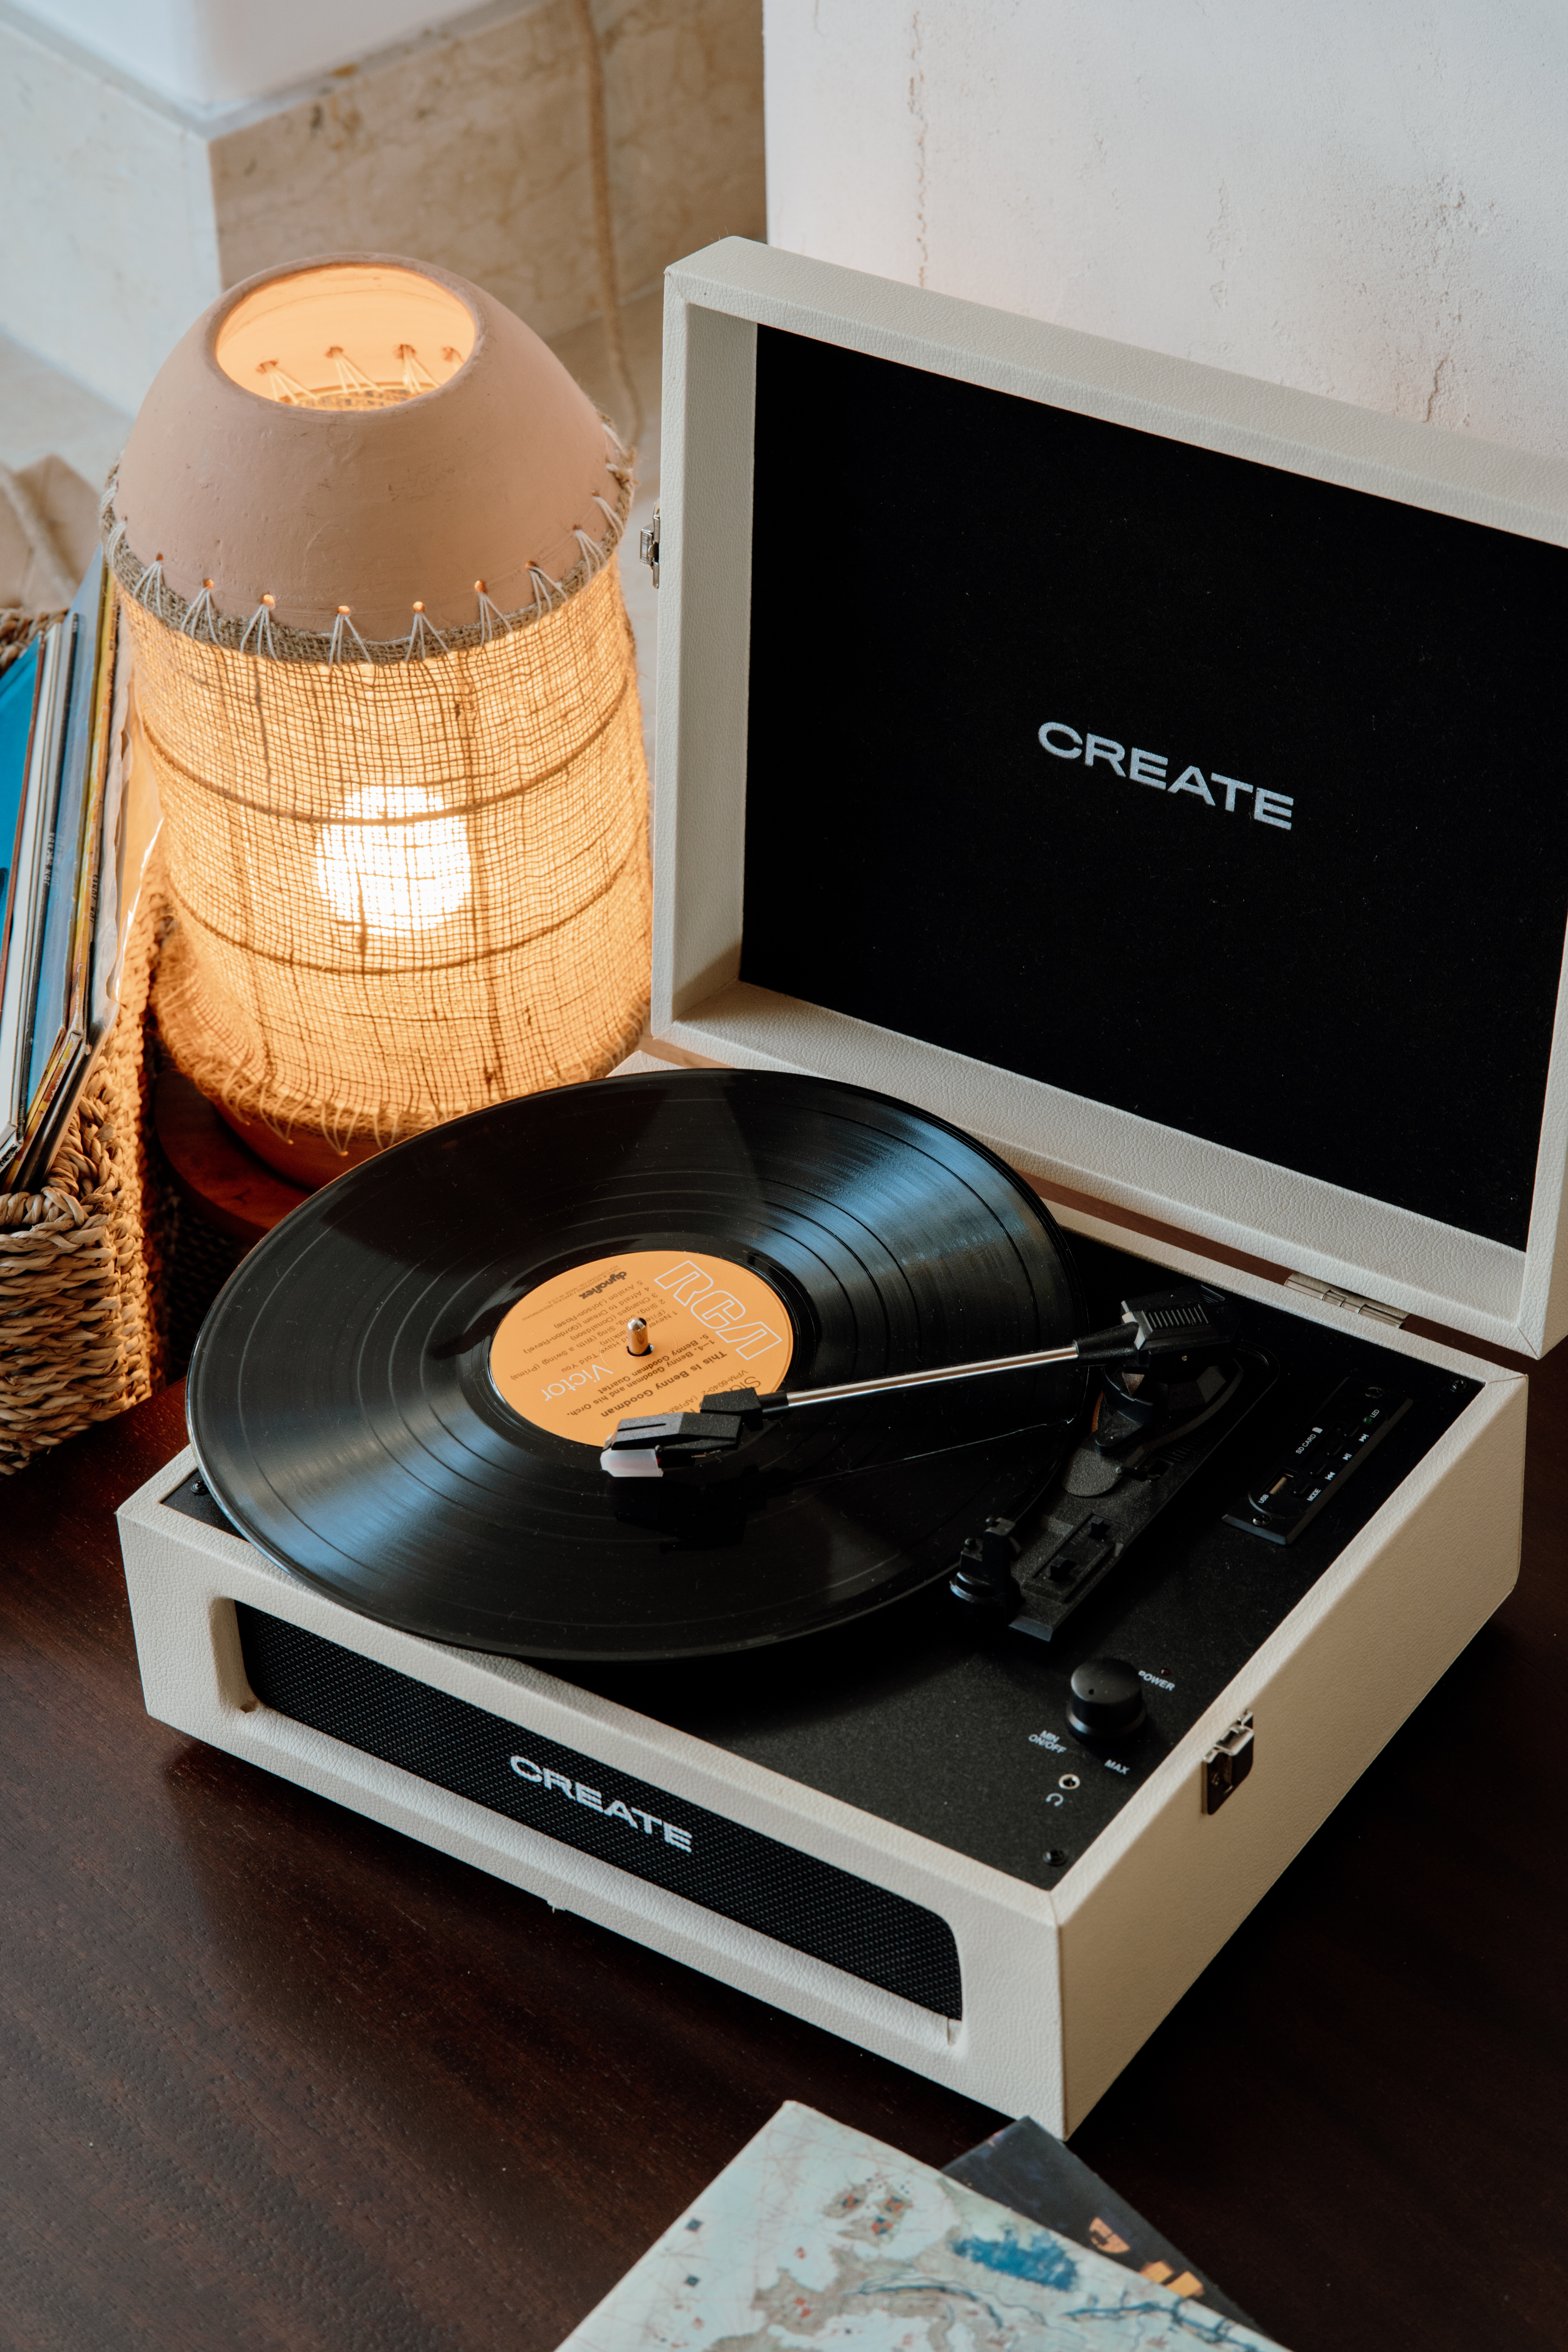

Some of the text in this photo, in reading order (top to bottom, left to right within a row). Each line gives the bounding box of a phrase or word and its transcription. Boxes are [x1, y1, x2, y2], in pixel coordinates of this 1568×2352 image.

[1038, 722, 1294, 830] CREATE
[579, 1272, 627, 1299] dynaflex
[608, 1285, 634, 1301] Avalon
[619, 1290, 642, 1305] Afraid
[554, 1299, 607, 1328] (Jolson-Rose)
[617, 1297, 650, 1316] Changes
[637, 1303, 657, 1314] Sing,
[654, 1260, 782, 1360] RCA
[583, 1310, 608, 1324] Dream
[649, 1314, 671, 1328] Never
[570, 1315, 616, 1340] (Donaldson)
[597, 1326, 615, 1337] Sing
[523, 1323, 582, 1354] (Gordon-Revel)
[576, 1335, 596, 1348] (With
[600, 1341, 619, 1353] Have
[671, 1340, 699, 1355] Benny
[542, 1350, 568, 1365] Swing)
[579, 1353, 599, 1365] Told
[666, 1352, 693, 1367] Benny
[703, 1351, 727, 1364] This
[510, 1364, 540, 1380] (Prima)
[561, 1363, 578, 1372] You
[632, 1356, 670, 1376] Goodman
[541, 1365, 613, 1401] Victor
[626, 1367, 665, 1387] Goodman
[655, 1371, 689, 1390] Benny
[701, 1370, 748, 1396] VPM-6040-2
[598, 1376, 630, 1394] Quartet
[609, 1387, 625, 1397] and
[593, 1396, 608, 1404] his
[601, 1390, 653, 1417] Goodman
[567, 1404, 591, 1416] Orch.
[1370, 1409, 1379, 1418] LED
[1302, 1434, 1316, 1447] CARD
[1258, 1494, 1269, 1503] USB
[1307, 1488, 1321, 1501] MODE
[1138, 1670, 1175, 1691] POWER
[1029, 1734, 1067, 1753] ON/OFF
[1040, 1730, 1060, 1743] MIN
[1104, 1759, 1130, 1775] MAX
[510, 1756, 692, 1853] CREATE
